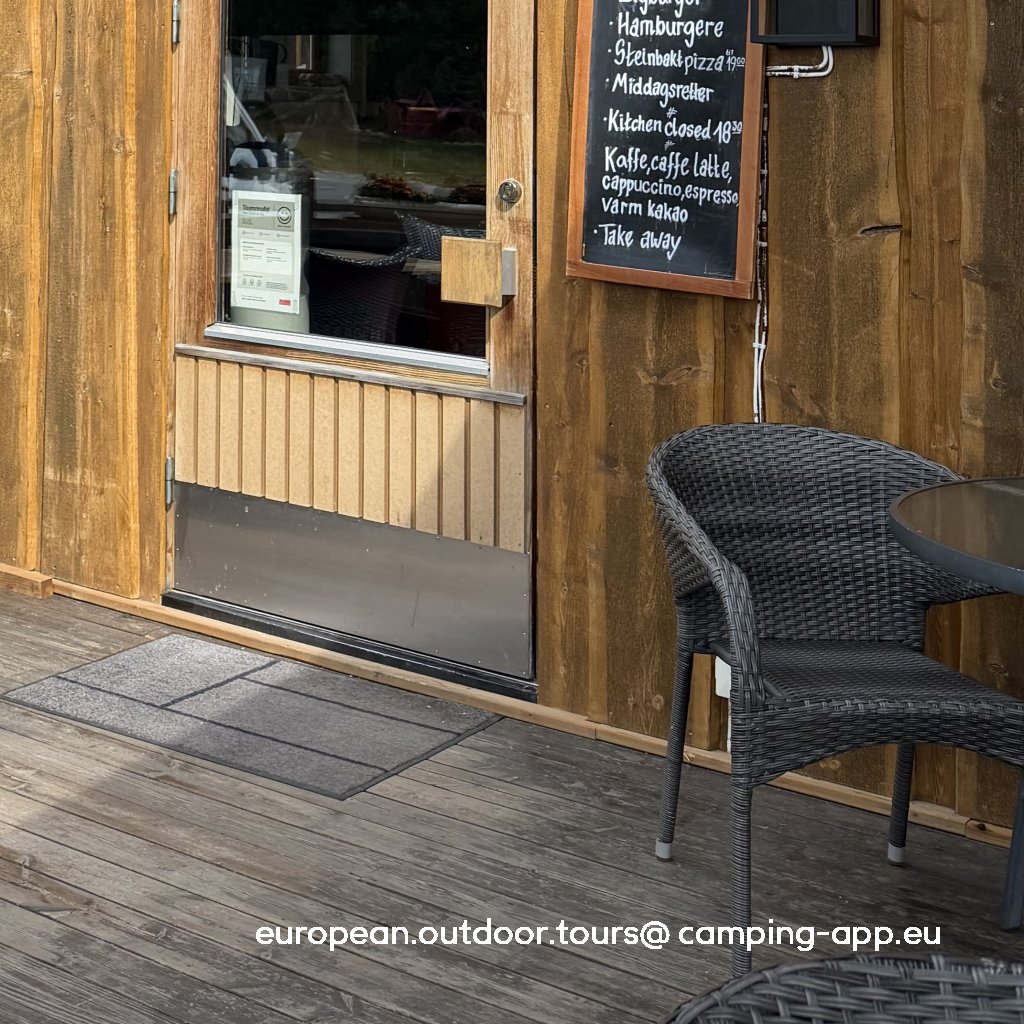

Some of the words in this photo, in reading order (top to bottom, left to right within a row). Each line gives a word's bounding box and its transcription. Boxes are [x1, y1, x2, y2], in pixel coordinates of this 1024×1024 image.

[617, 12, 724, 48] Hamburgere
[612, 72, 714, 108] Middagsretter
[608, 108, 662, 132] Kitchen
[664, 118, 711, 140] closed
[647, 199, 688, 223] kakao
[598, 223, 634, 248] Take
[640, 230, 682, 261] away
